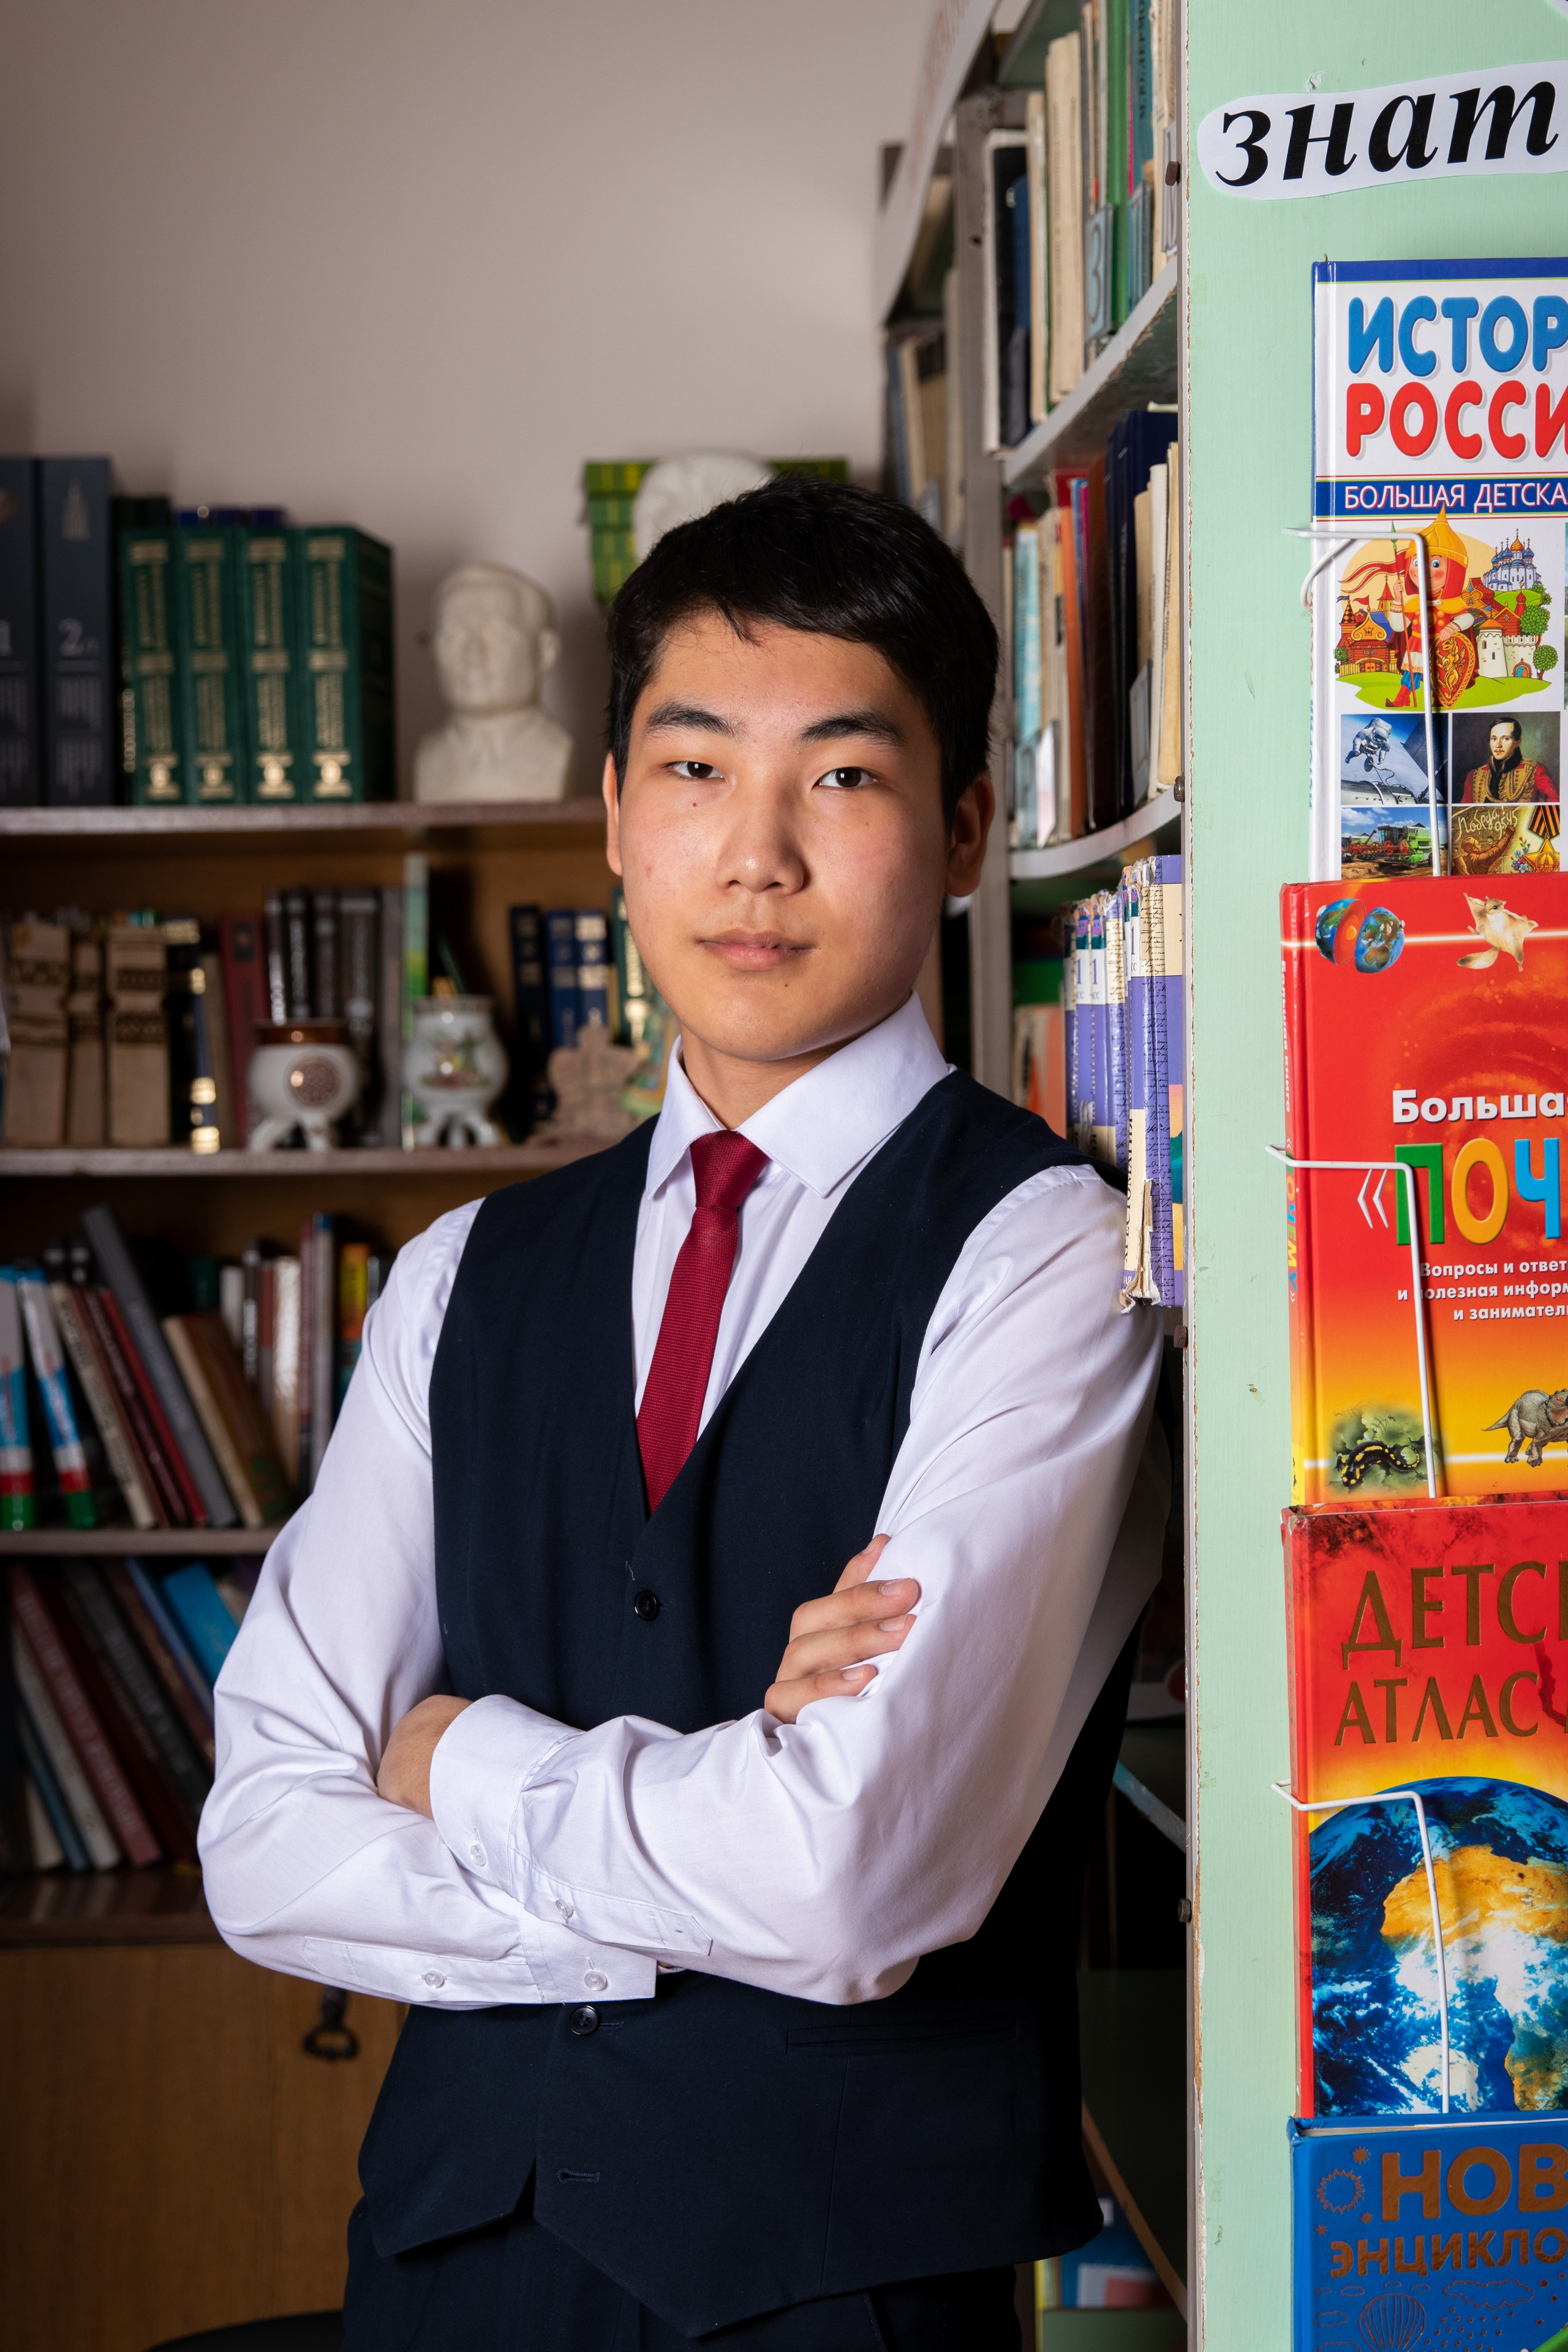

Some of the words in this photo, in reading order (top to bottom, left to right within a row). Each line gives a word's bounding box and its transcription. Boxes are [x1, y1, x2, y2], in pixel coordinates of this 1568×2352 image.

[1215, 81, 1559, 187] знат
[1348, 295, 1568, 376] ИСТОР
[1347, 380, 1568, 460] РОССИ
[1345, 484, 1464, 509] БОЛЬШАЯ
[1474, 483, 1568, 513] ДЕТСКА
[1393, 1090, 1568, 1123] Больша
[1398, 1289, 1408, 1300] и
[1420, 1262, 1498, 1280] Вопросы
[1504, 1262, 1513, 1273] и
[1519, 1260, 1567, 1273] ответ
[1453, 1309, 1464, 1321] и
[1470, 1305, 1568, 1321] занимател
[1335, 1671, 1539, 1746] АТЛАС
[1382, 2143, 1568, 2222] НОВ
[1330, 2226, 1568, 2278] ЭНЦИКЛО
